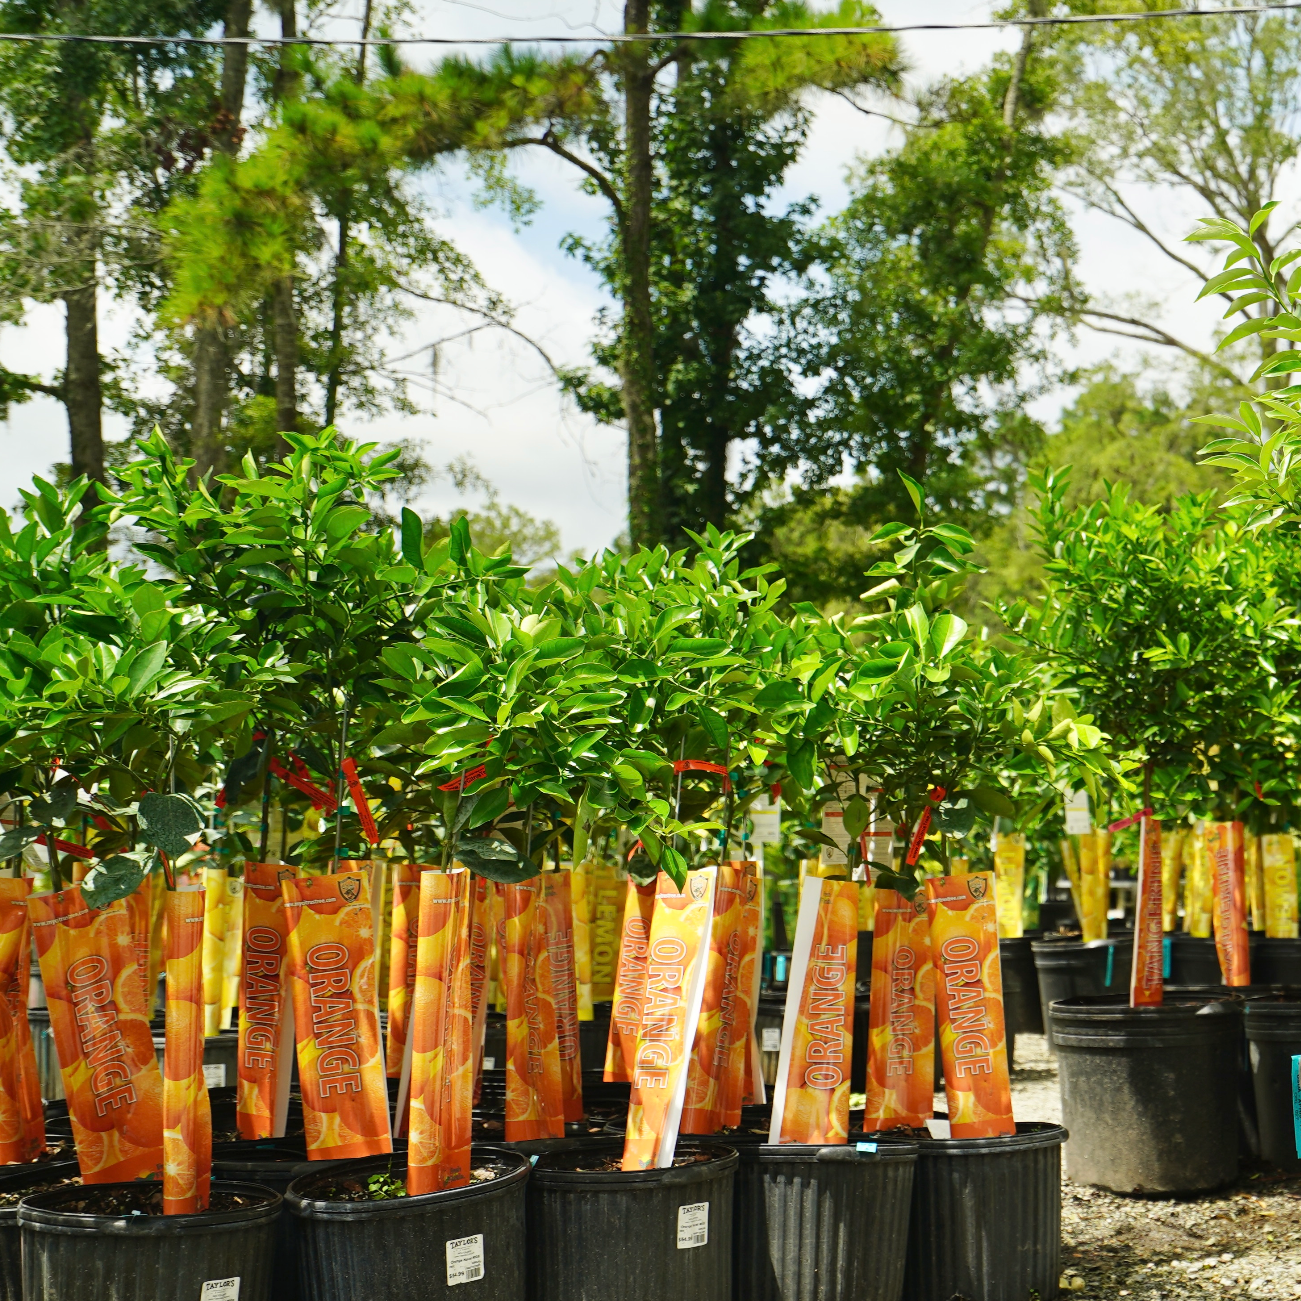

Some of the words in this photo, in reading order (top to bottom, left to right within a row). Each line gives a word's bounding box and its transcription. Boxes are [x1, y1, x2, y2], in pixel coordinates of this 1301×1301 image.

[244, 926, 282, 1071] ORANGE
[522, 930, 544, 1074] RANGE
[545, 928, 578, 1061] ORANGE
[593, 889, 618, 985] LEMON
[613, 916, 651, 1036] ORANGE
[713, 931, 740, 1068] ORANGE
[941, 936, 993, 1079] ORANGE
[66, 954, 137, 1118] ORANGE
[306, 942, 362, 1099] ORANGE
[633, 936, 687, 1090] ORANGE
[804, 944, 847, 1090] ORANGE
[886, 945, 915, 1078] ORANGE
